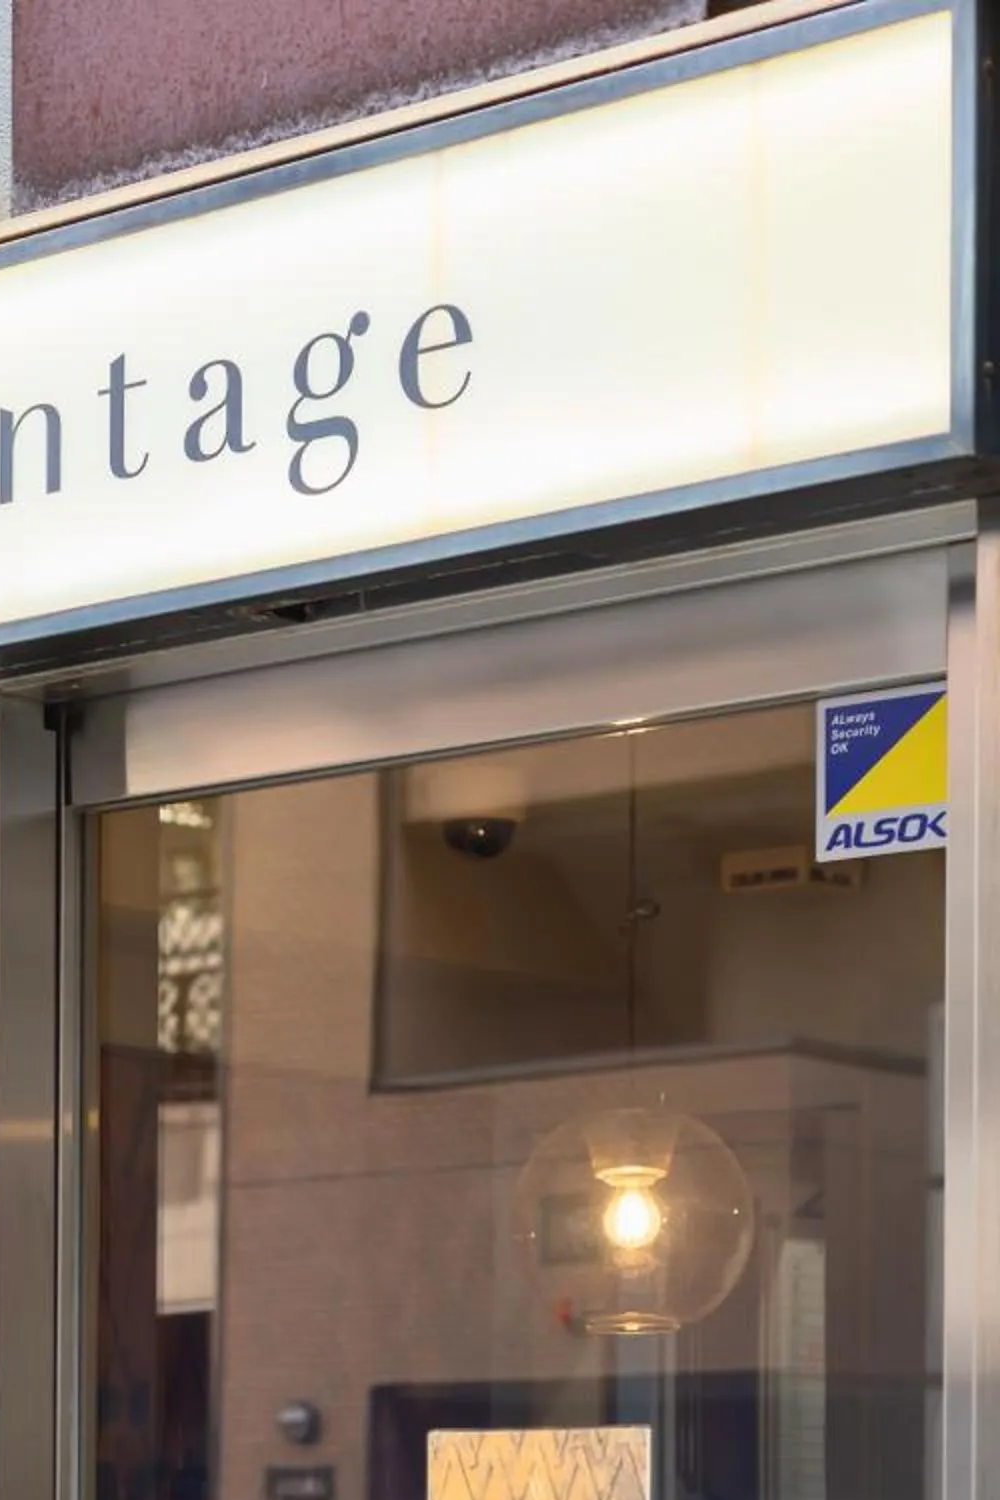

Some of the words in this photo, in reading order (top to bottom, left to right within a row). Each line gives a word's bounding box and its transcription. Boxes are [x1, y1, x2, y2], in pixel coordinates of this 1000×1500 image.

[831, 712, 876, 726] ALways
[831, 724, 881, 741] Security
[831, 742, 849, 755] OK
[826, 811, 947, 852] ALSOK
